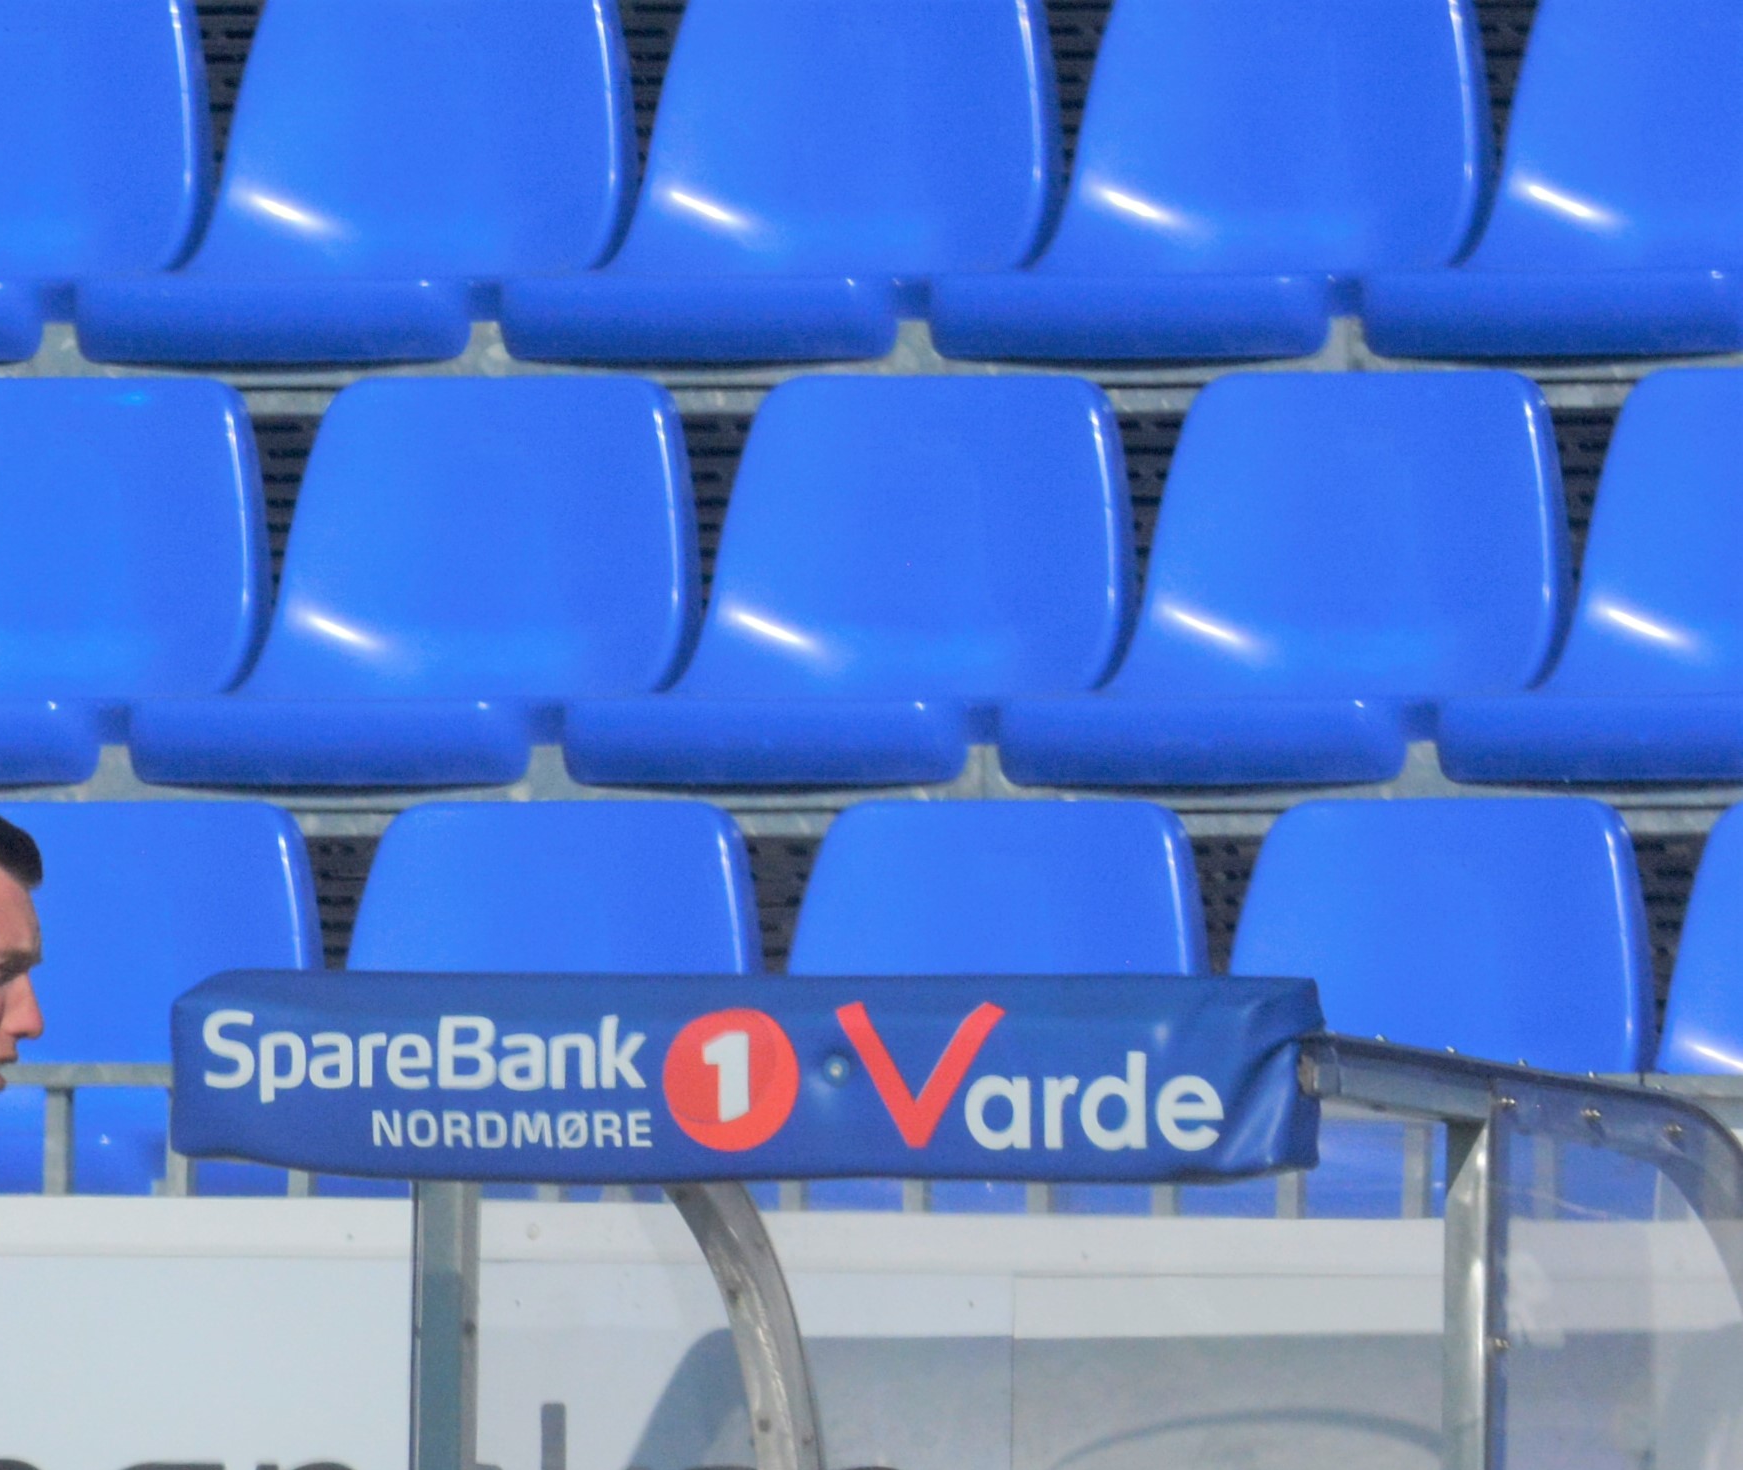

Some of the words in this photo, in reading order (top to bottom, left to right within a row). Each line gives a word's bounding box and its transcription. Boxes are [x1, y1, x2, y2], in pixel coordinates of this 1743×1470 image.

[202, 1009, 647, 1104] SpareBank
[701, 1029, 752, 1124] 1
[835, 1001, 1225, 1152] Varde
[371, 1108, 653, 1149] NORDMØRE
